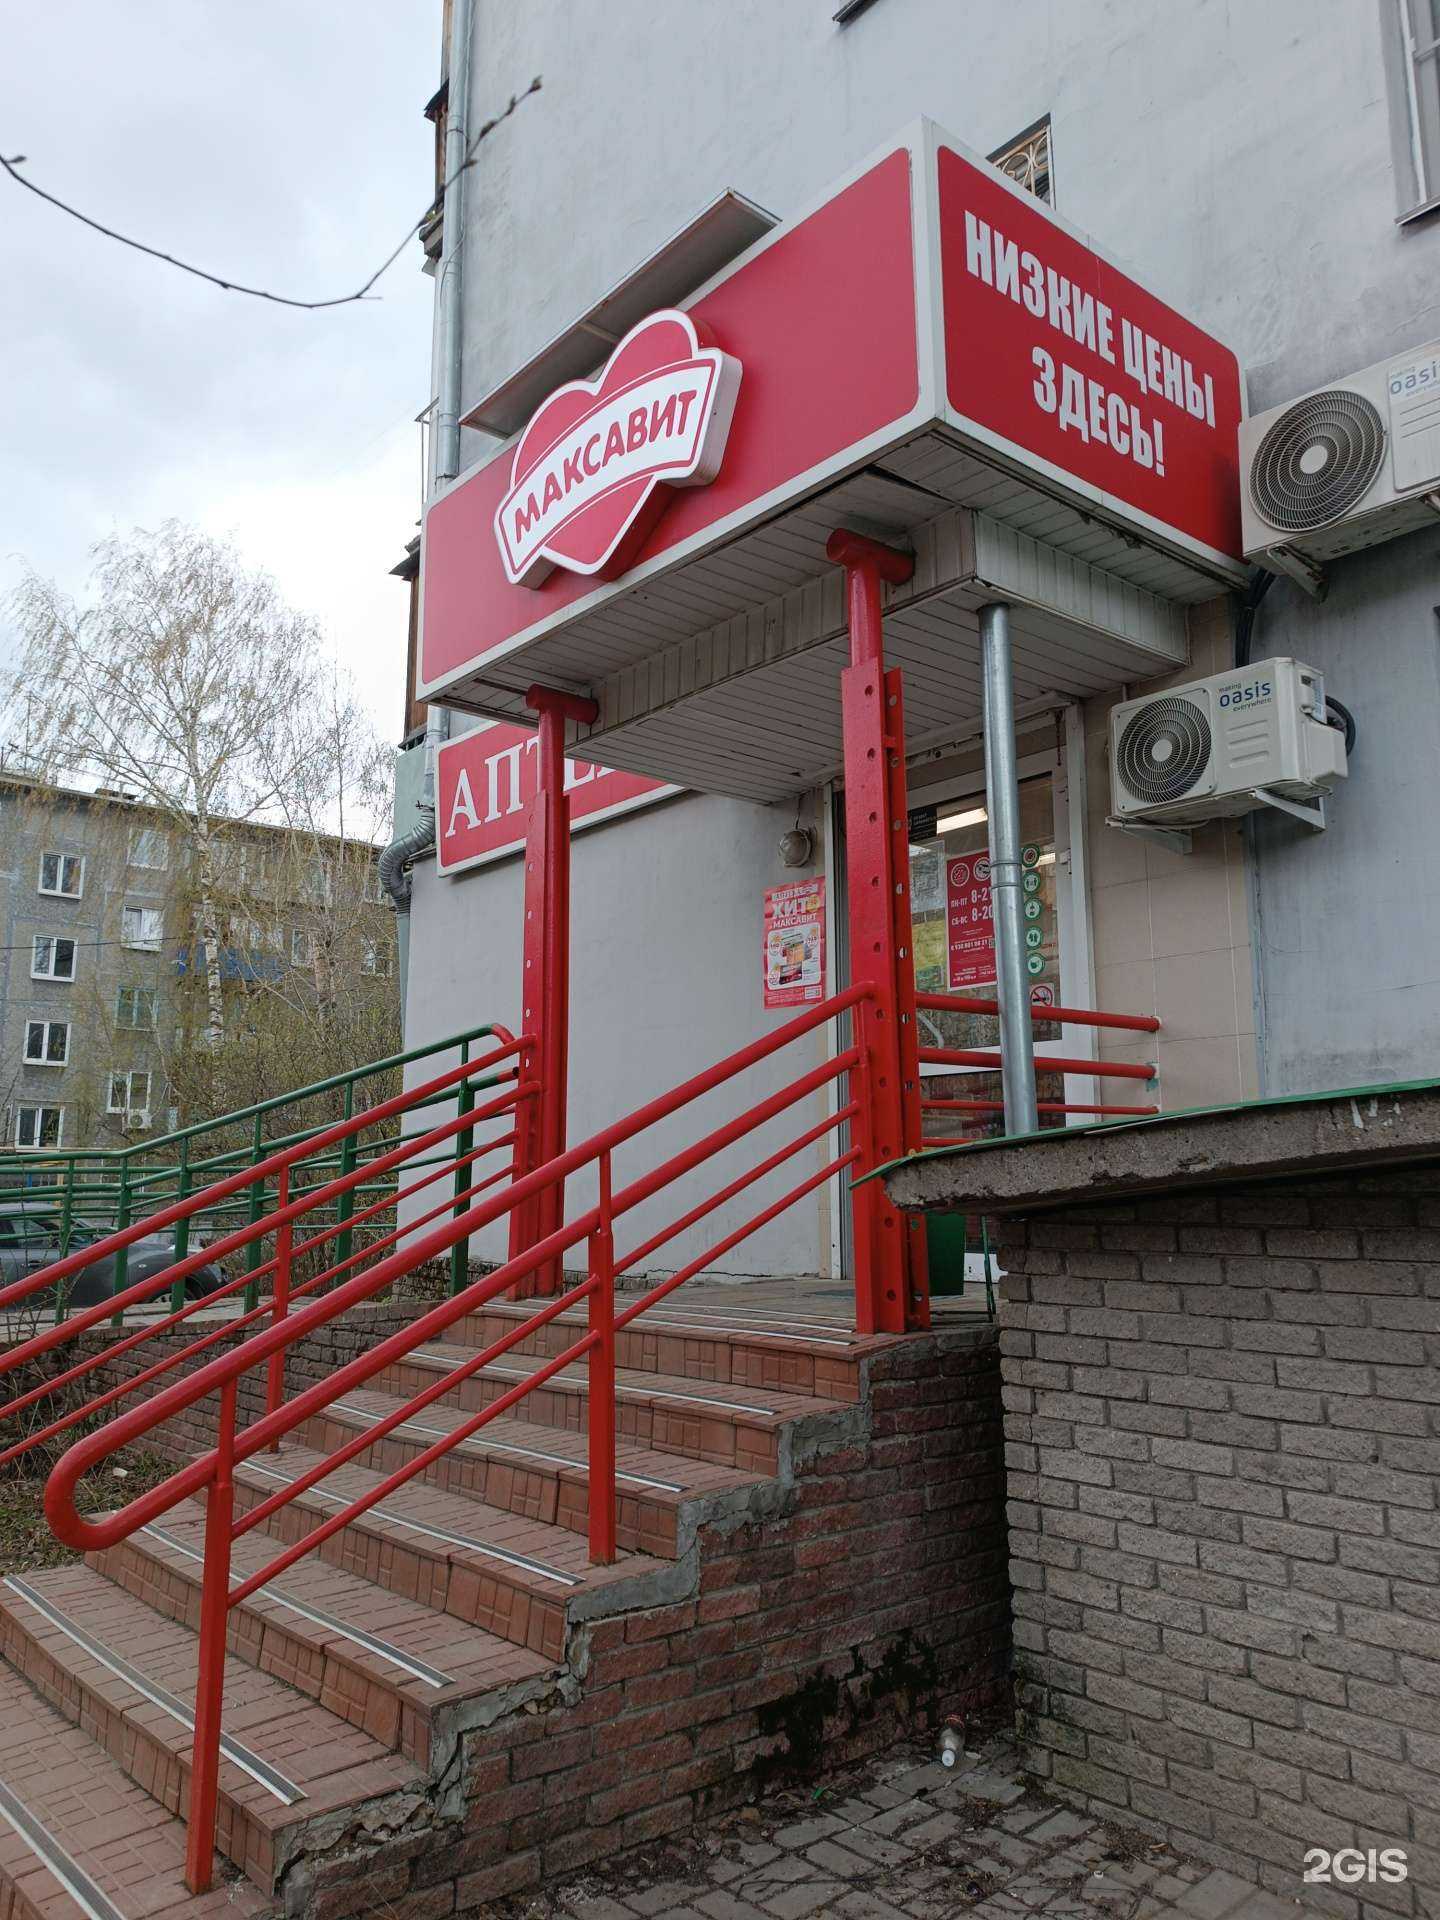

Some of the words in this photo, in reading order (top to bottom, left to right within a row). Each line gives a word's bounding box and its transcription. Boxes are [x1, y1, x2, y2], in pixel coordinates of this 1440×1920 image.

[964, 209, 1116, 366] НИЗКИЕ
[1121, 317, 1216, 429] ЦЕНЫ
[1390, 360, 1440, 395] oasi
[514, 389, 698, 544] МАКСАВИТ
[1032, 346, 1165, 478] ЗДЕСЬ!
[1219, 681, 1271, 708] oasis
